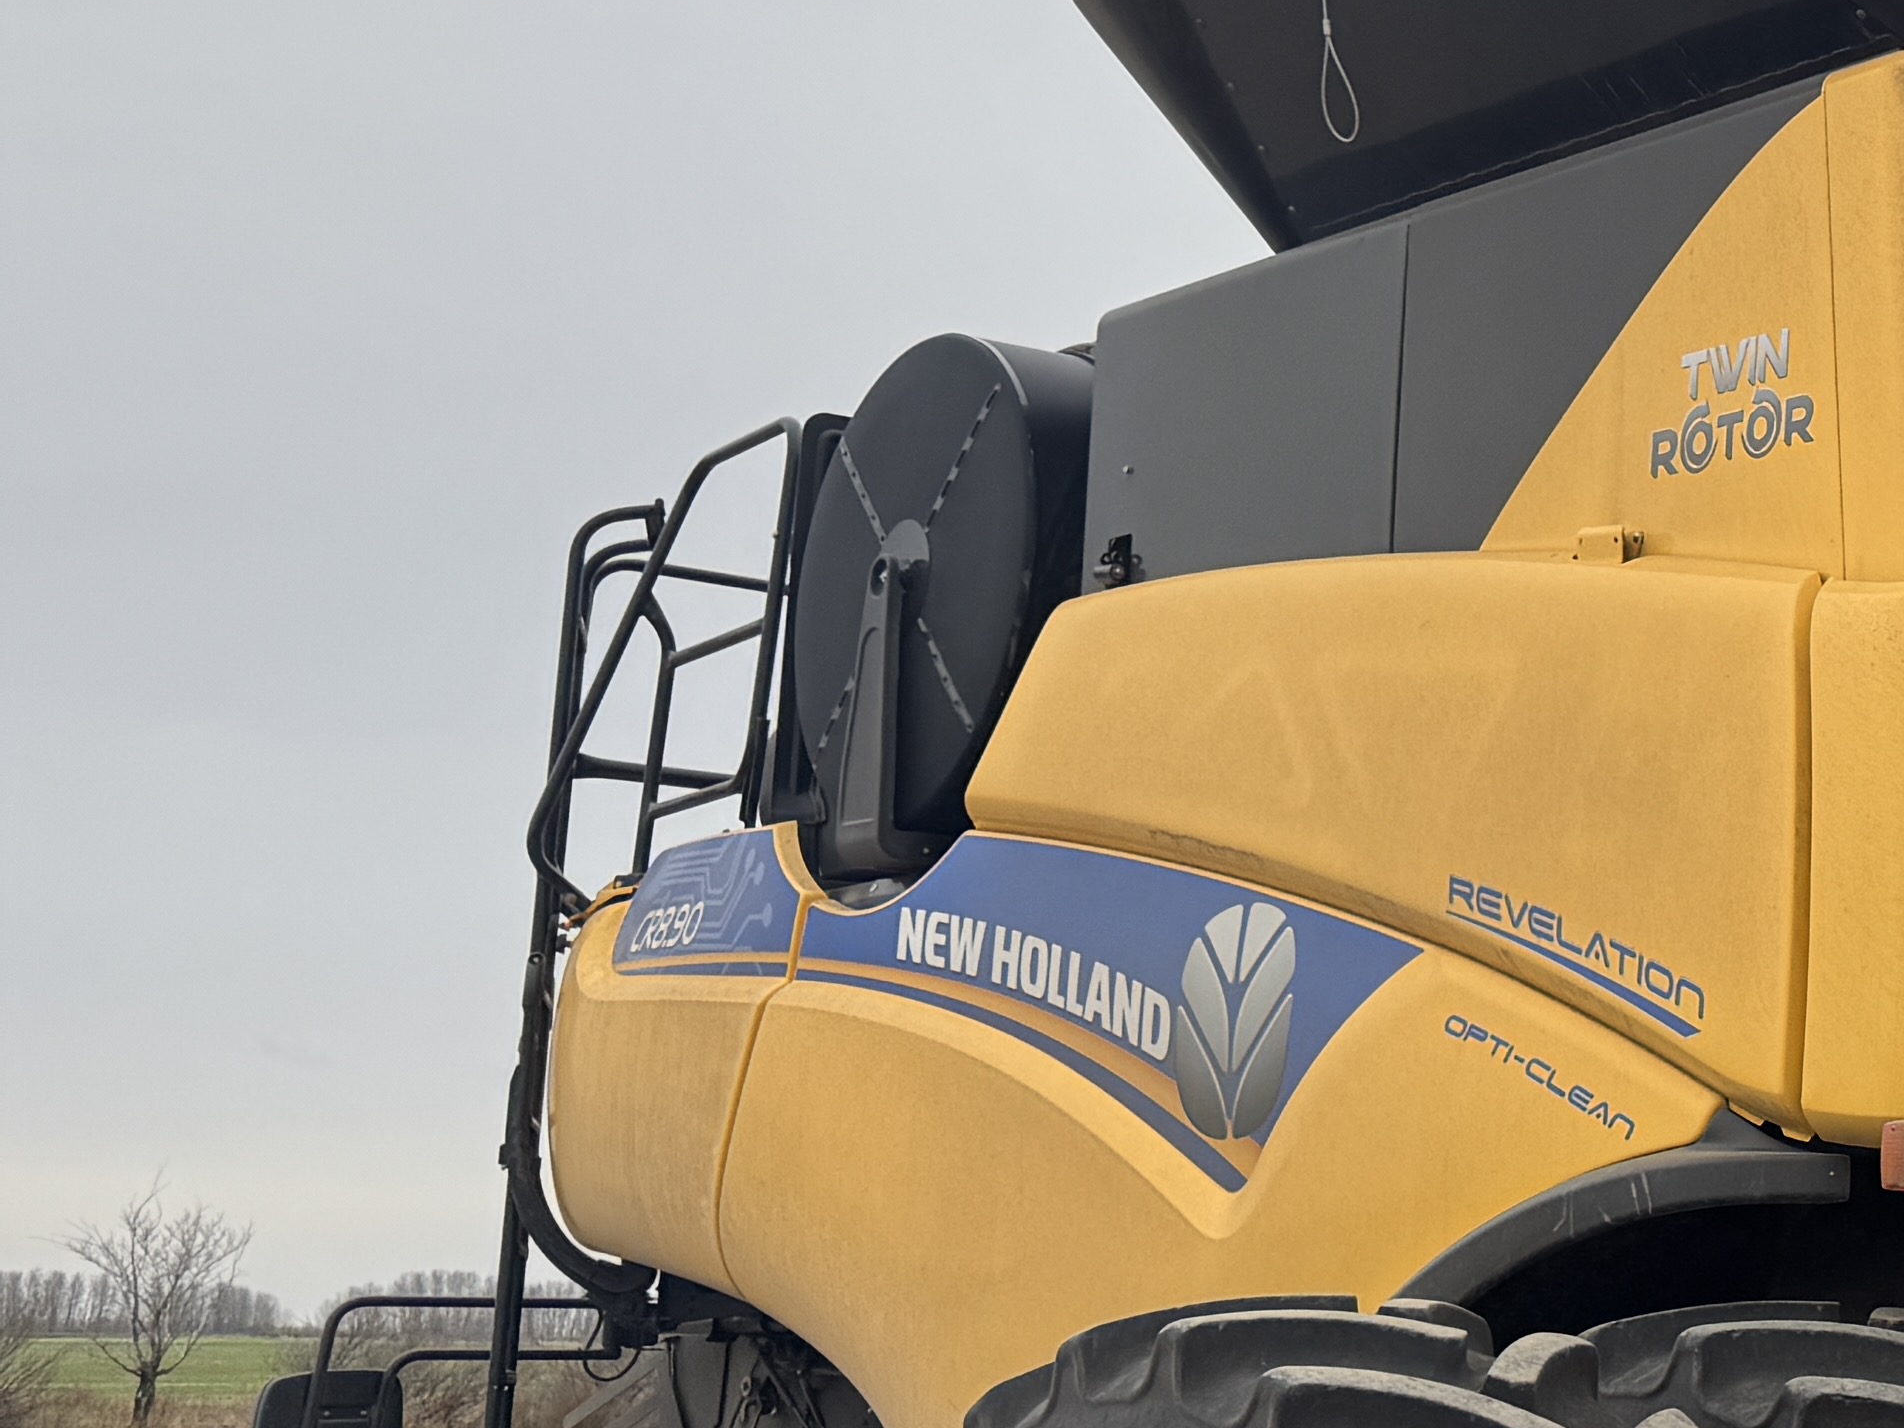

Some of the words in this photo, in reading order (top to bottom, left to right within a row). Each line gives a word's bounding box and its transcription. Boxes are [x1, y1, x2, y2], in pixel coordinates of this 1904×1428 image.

[1680, 327, 1791, 401] TWIN
[1650, 386, 1816, 479] ROTOR
[630, 900, 705, 953] CR8.90
[1447, 872, 1706, 1021] REVELATION
[895, 905, 988, 978] NEW
[993, 923, 1173, 1062] HOLLAND
[1443, 1012, 1637, 1142] OPTI-CLEAN
